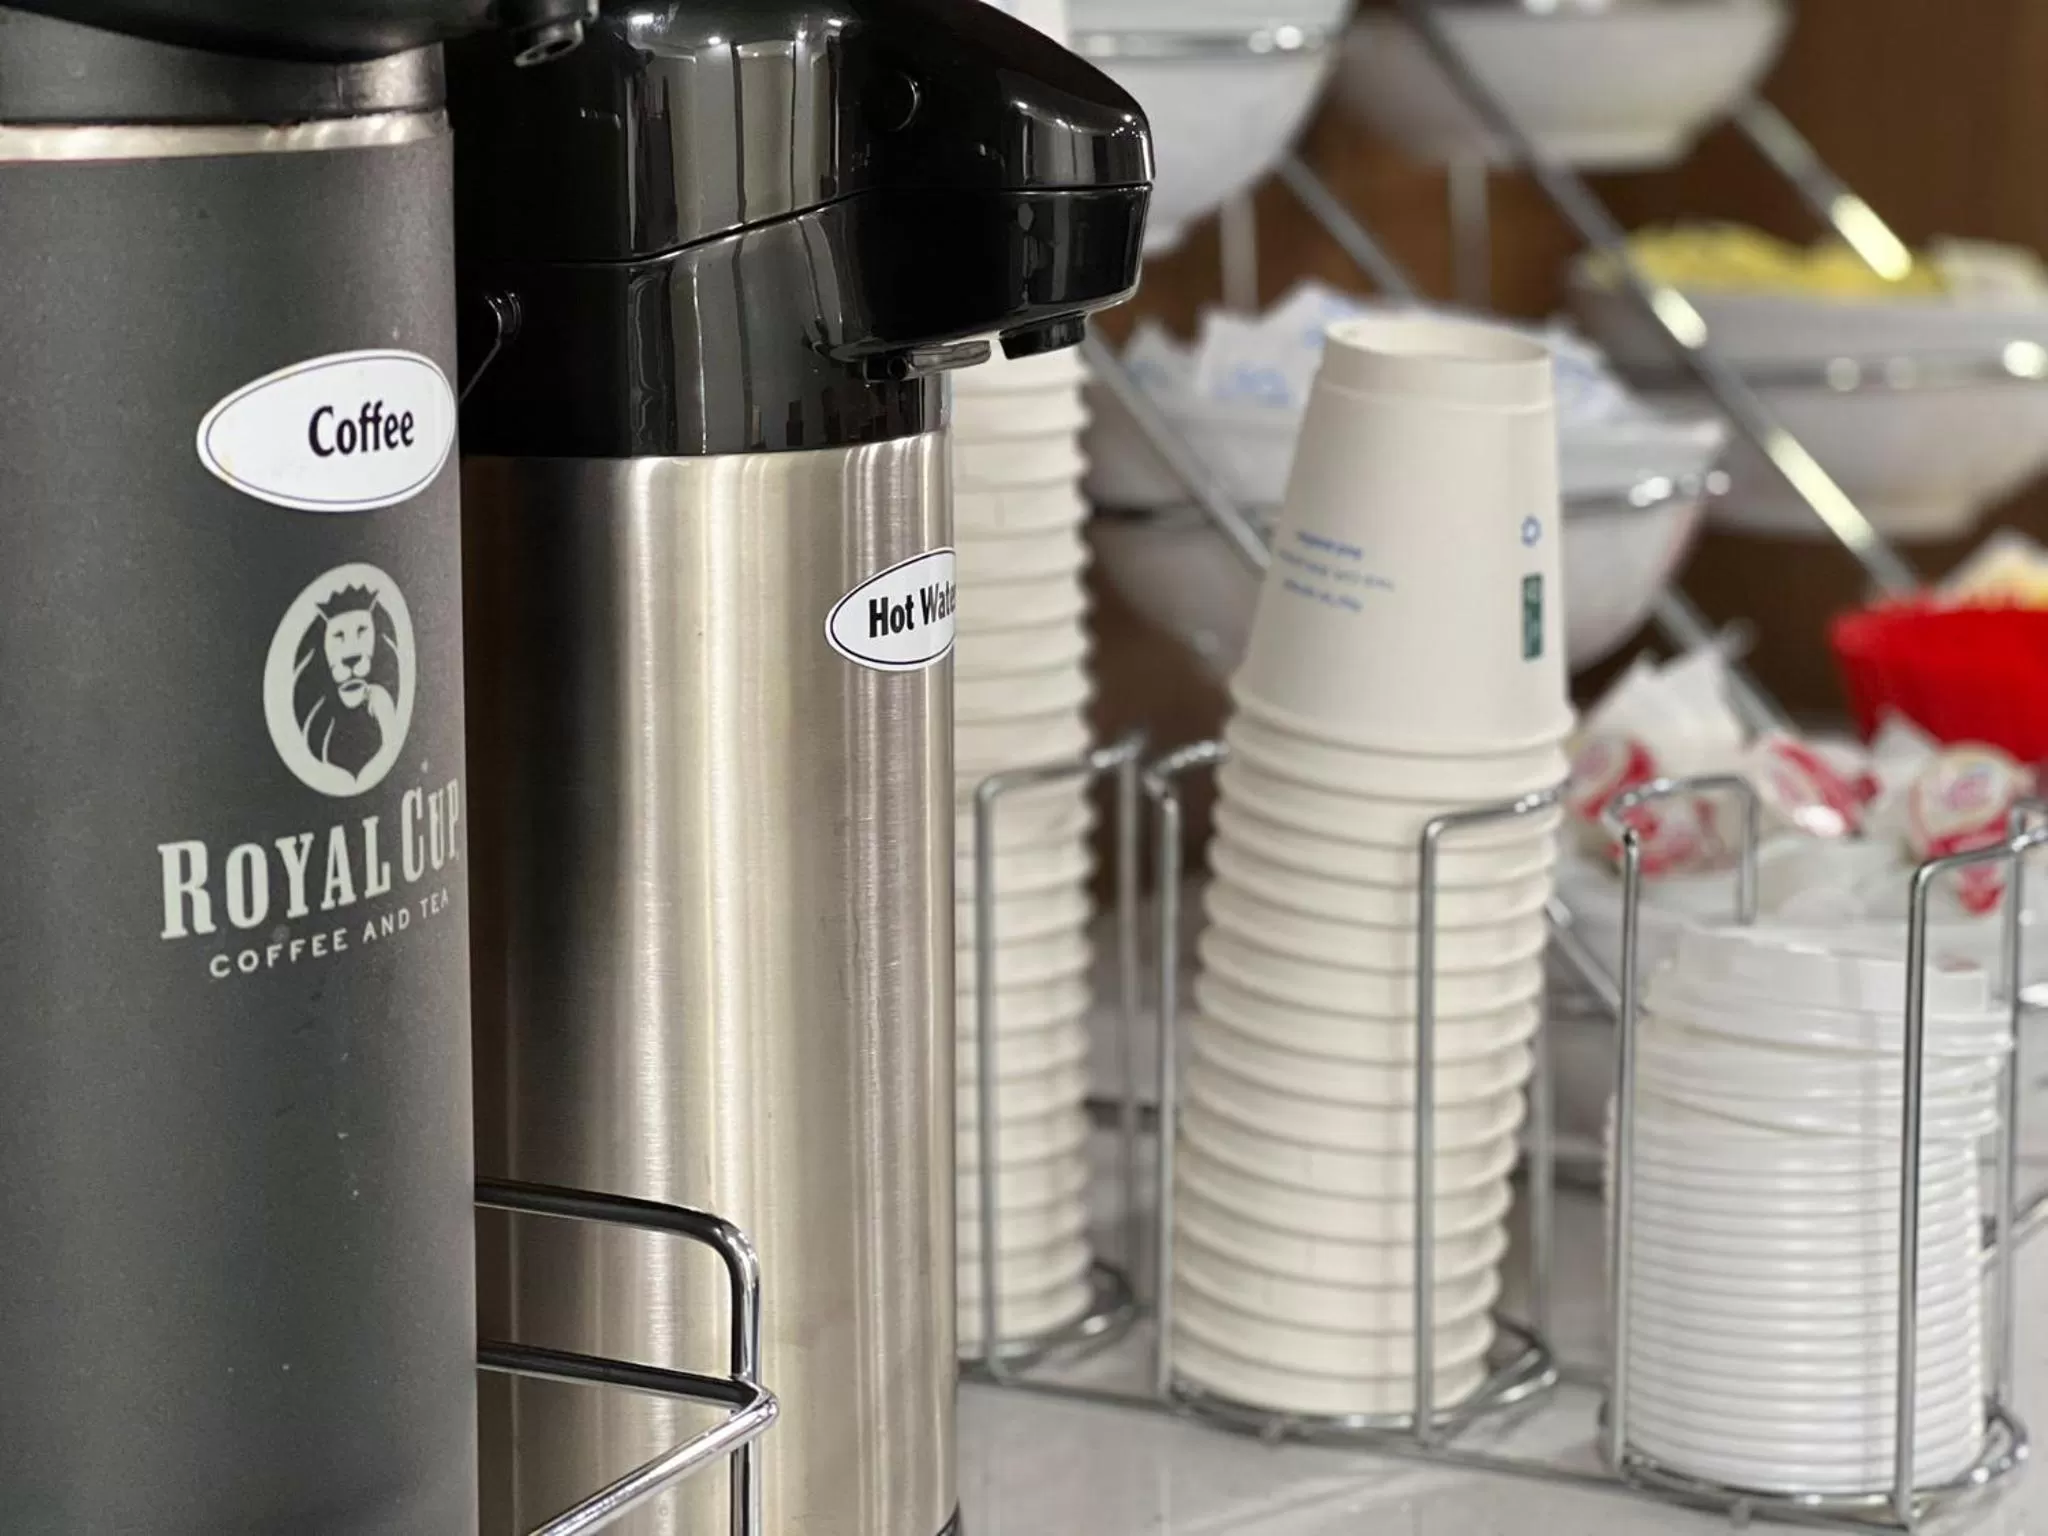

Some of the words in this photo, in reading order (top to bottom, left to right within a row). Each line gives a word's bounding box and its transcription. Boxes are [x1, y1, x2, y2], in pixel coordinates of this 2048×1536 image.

[308, 398, 414, 458] Coffee
[869, 596, 914, 638] Hot
[920, 580, 956, 625] Wate
[157, 817, 392, 940] ROYAL
[402, 778, 459, 882] CUP
[209, 928, 349, 979] COFFEE
[363, 907, 411, 943] AND
[419, 887, 449, 919] TEA
